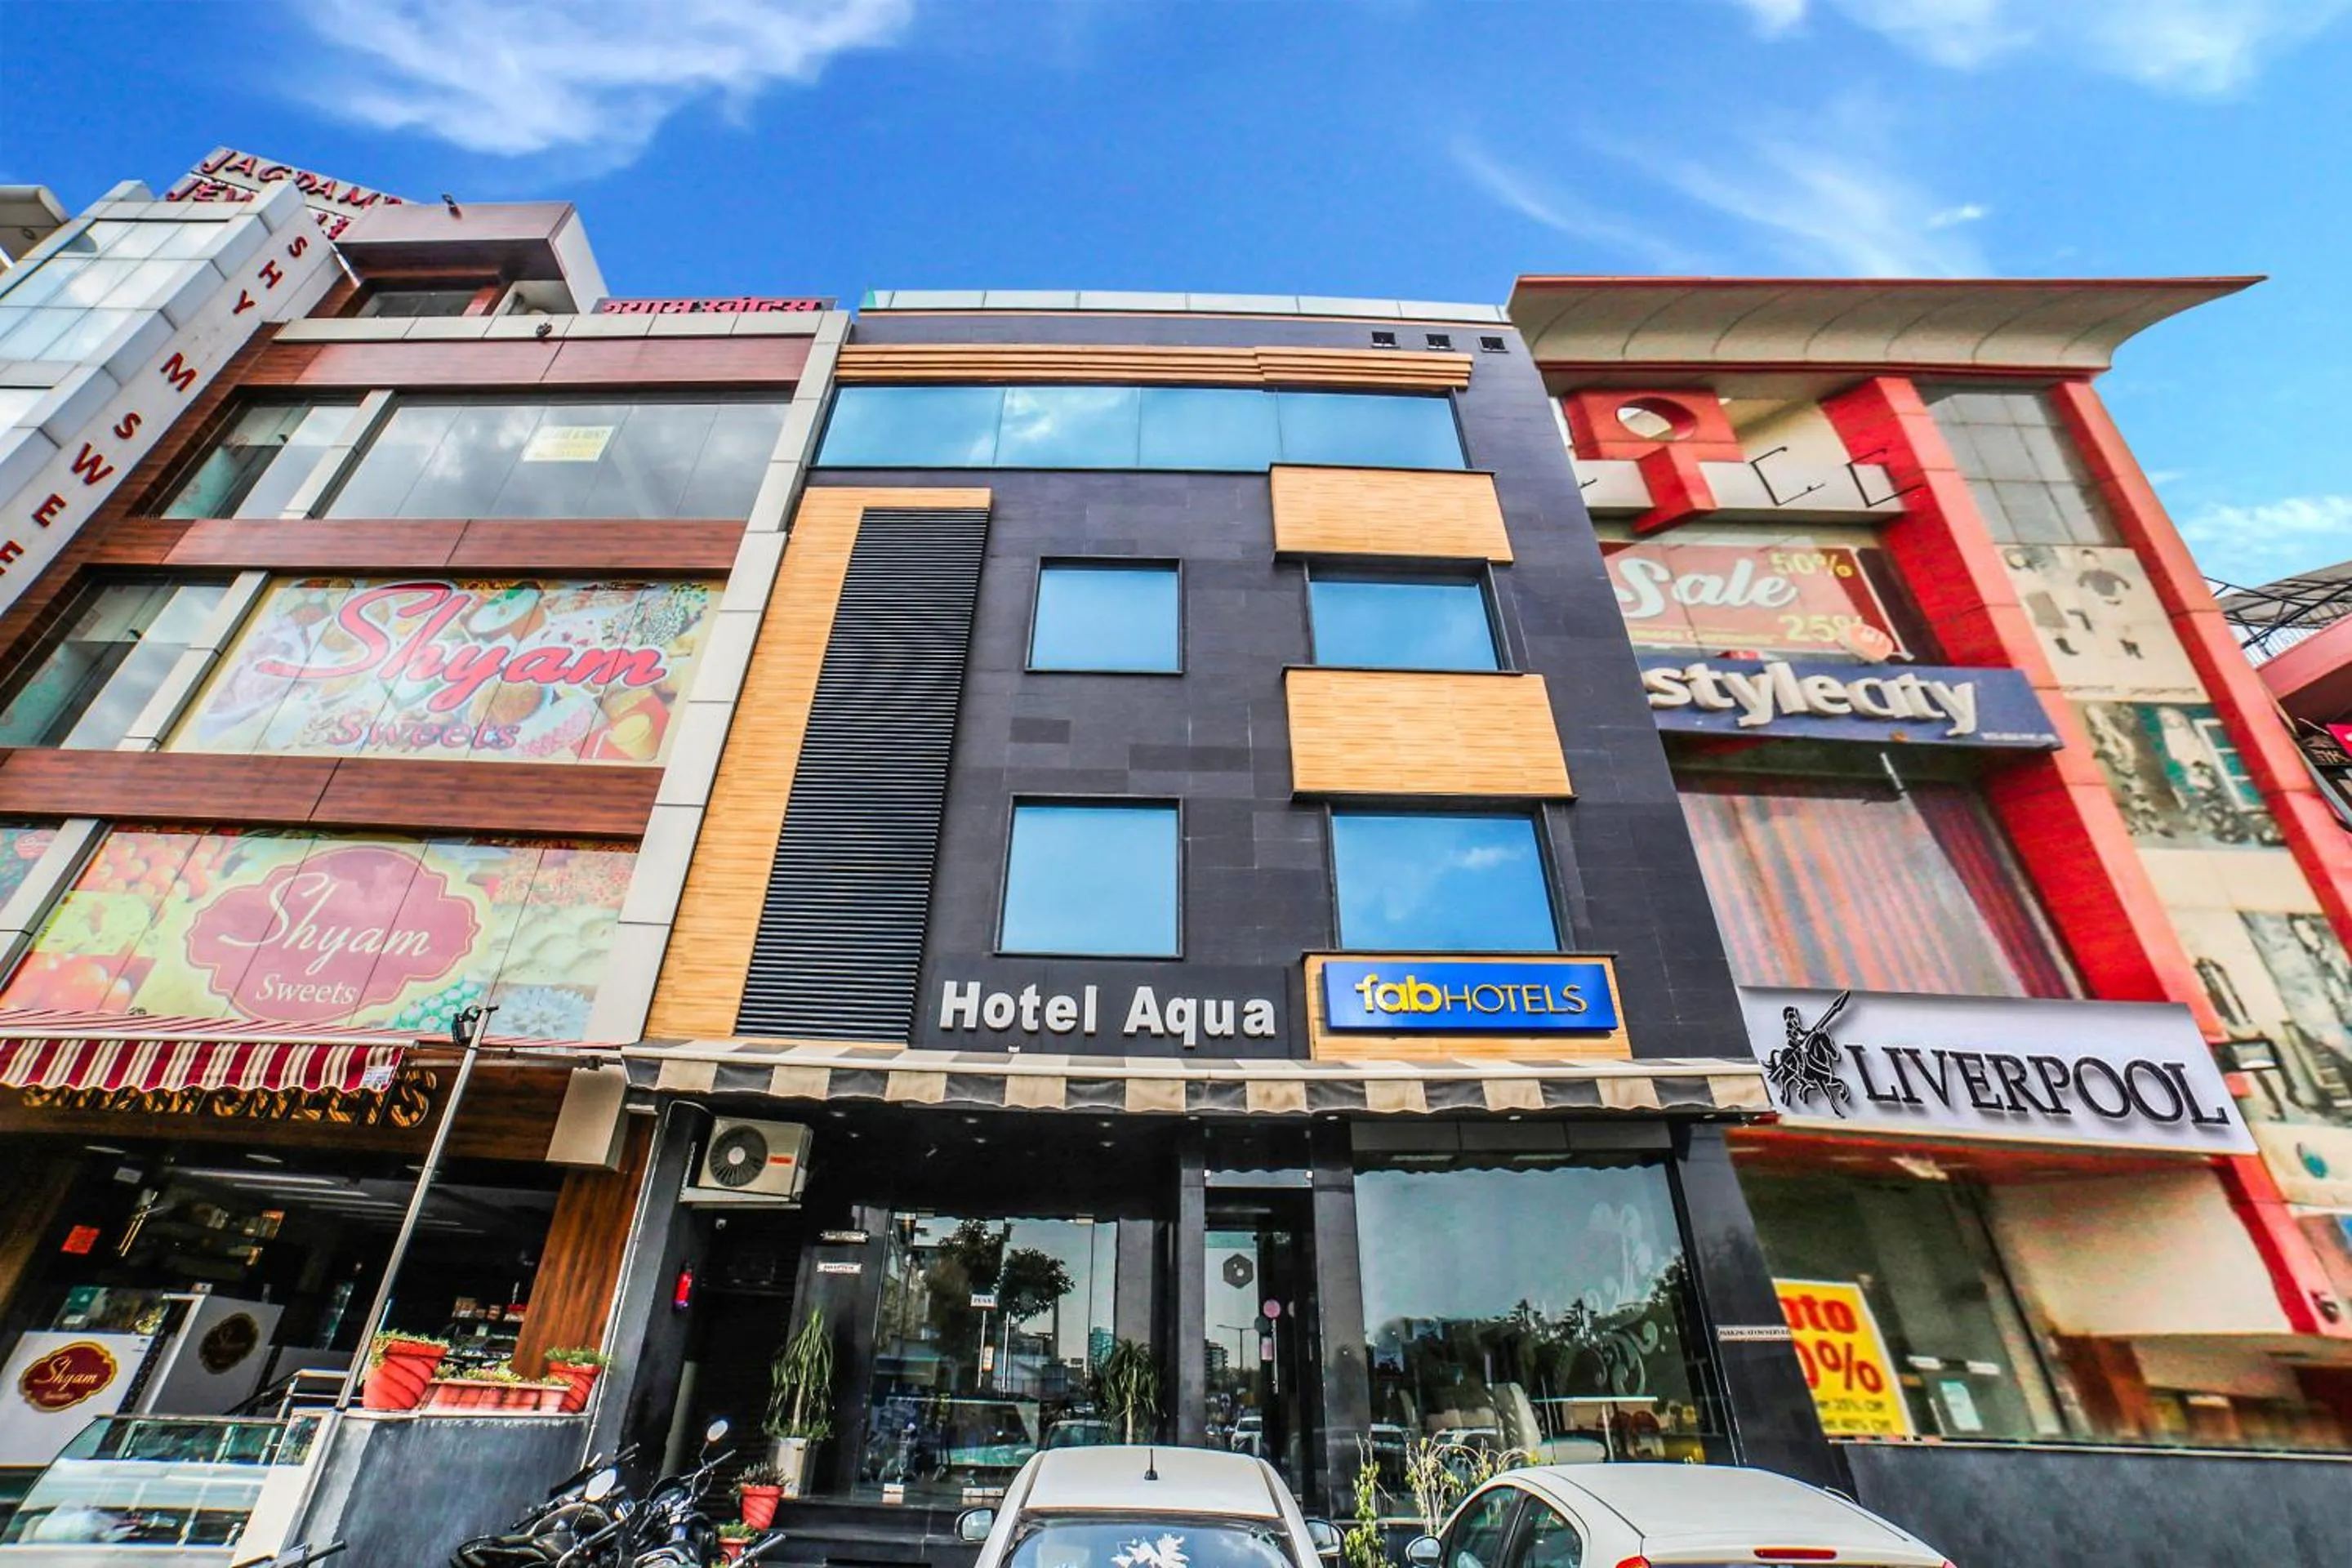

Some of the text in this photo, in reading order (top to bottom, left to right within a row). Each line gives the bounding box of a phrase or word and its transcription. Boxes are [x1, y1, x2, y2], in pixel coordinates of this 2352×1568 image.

[1613, 557, 1798, 619] Sale
[1768, 552, 1854, 578] 50%
[255, 579, 669, 713] Shyam
[217, 871, 433, 974] Shyam
[254, 973, 357, 1006] Sweets
[938, 980, 1277, 1047] Hotel Aqua
[1843, 1043, 2231, 1127] LIVERPOOL
[33, 1355, 98, 1392] Shyam
